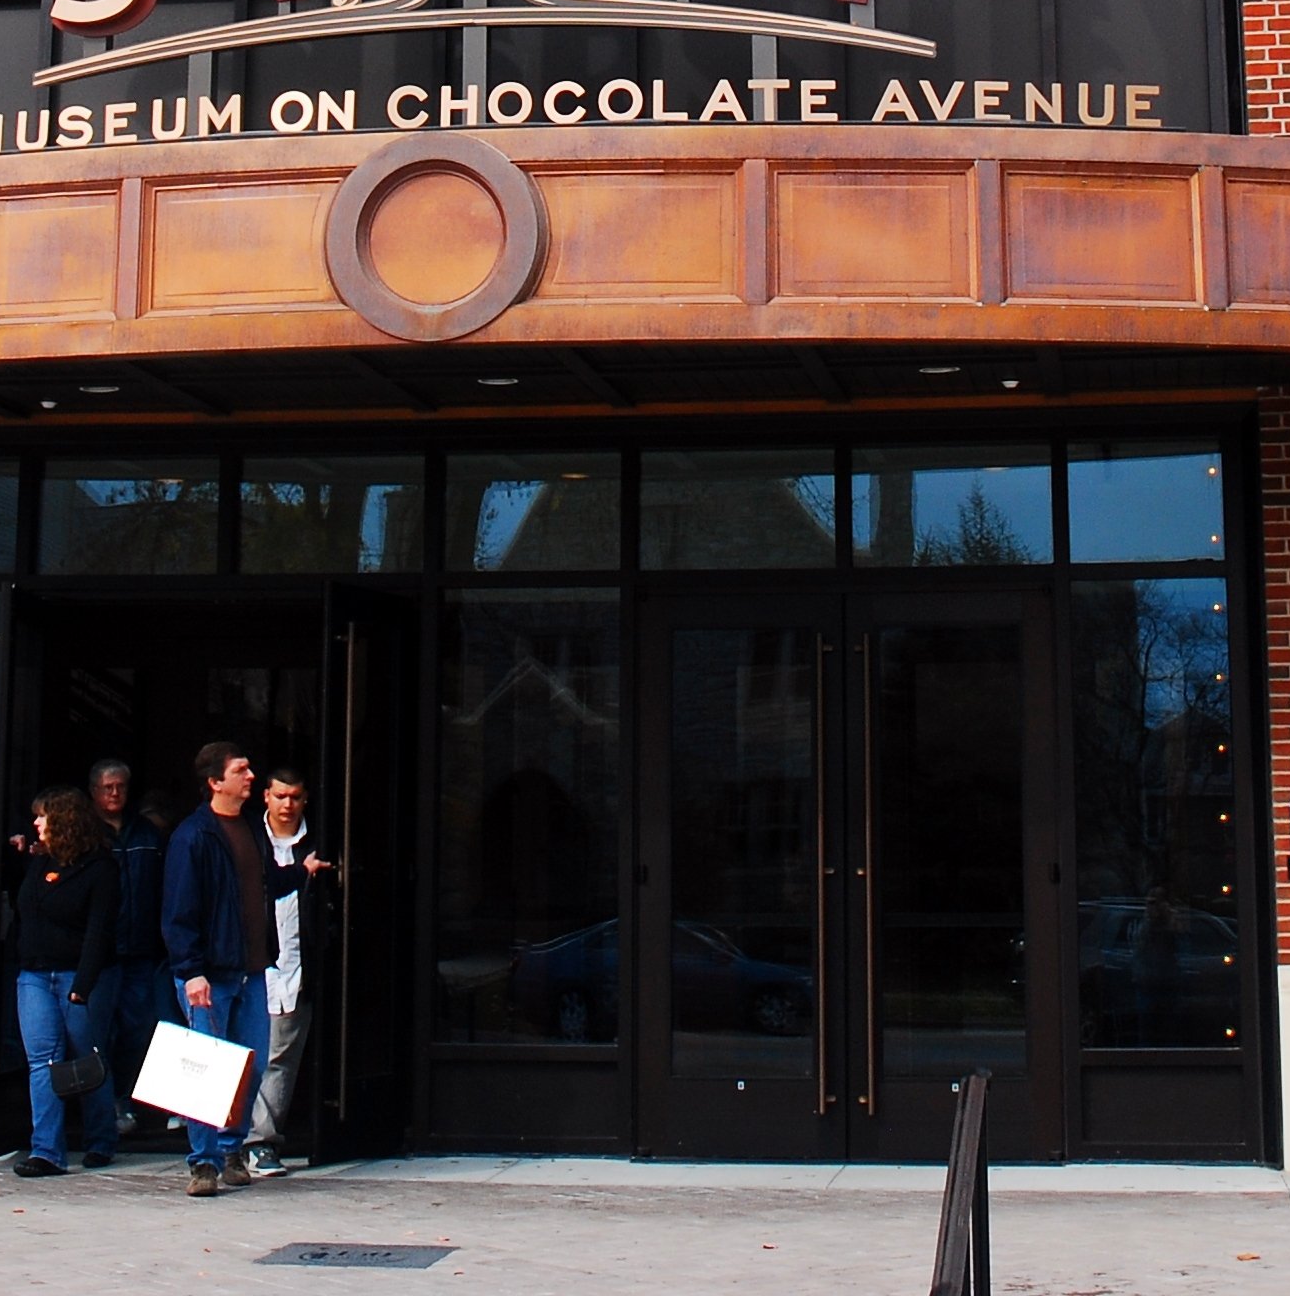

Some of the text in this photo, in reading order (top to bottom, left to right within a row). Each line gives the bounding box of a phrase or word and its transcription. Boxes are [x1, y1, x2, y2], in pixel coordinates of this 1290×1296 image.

[270, 89, 356, 133] ON
[386, 78, 840, 129] CHOCOLATE
[870, 79, 1164, 129] AVENUE
